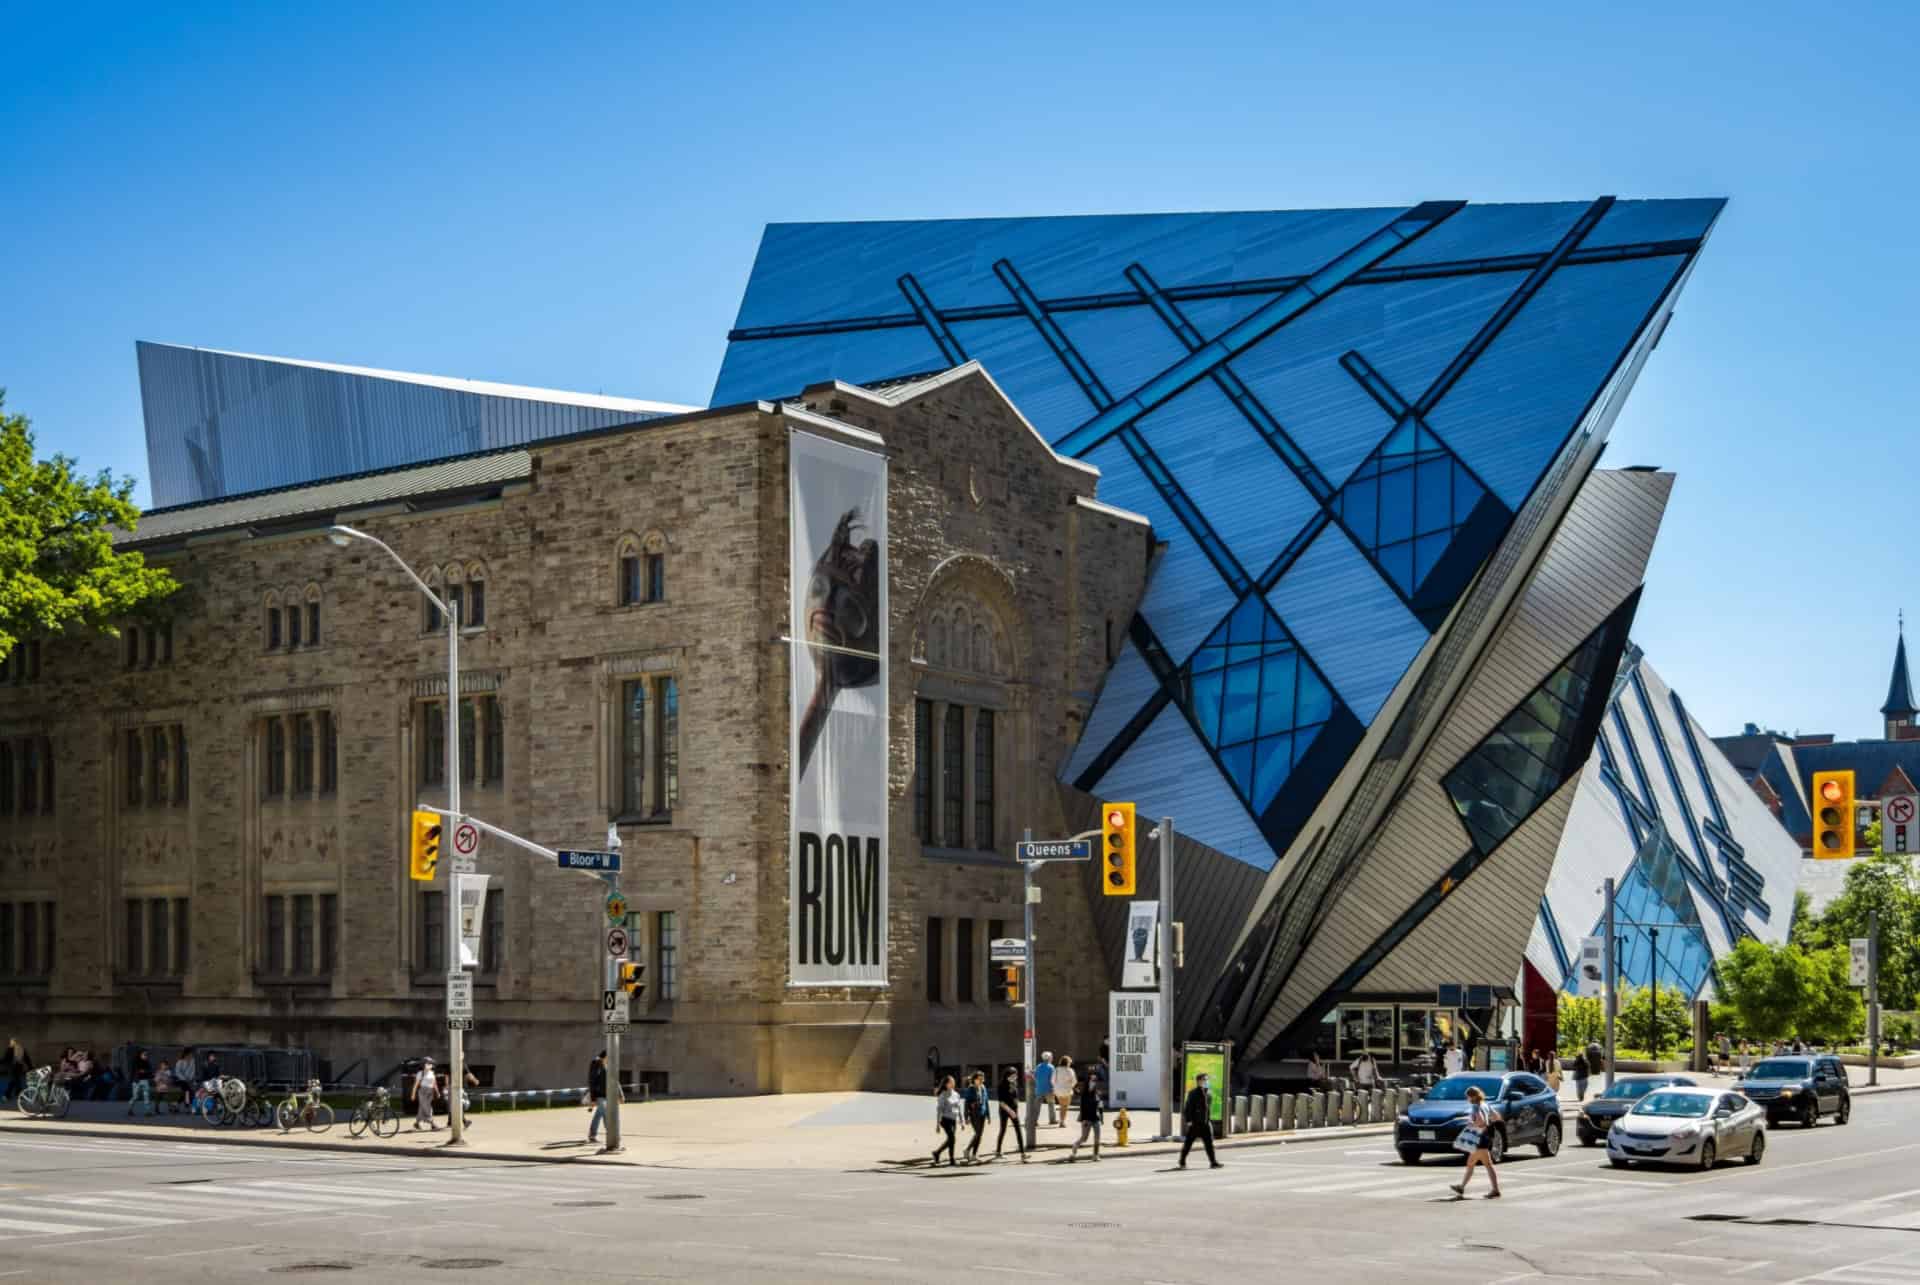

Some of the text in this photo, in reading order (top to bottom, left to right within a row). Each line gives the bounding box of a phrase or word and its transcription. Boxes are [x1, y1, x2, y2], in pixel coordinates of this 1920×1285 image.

[1026, 843, 1071, 857] Queens
[570, 852, 595, 866] Bloor
[602, 855, 610, 867] W
[799, 832, 880, 966] ROM
[1116, 999, 1127, 1016] WE
[1143, 999, 1154, 1016] ON
